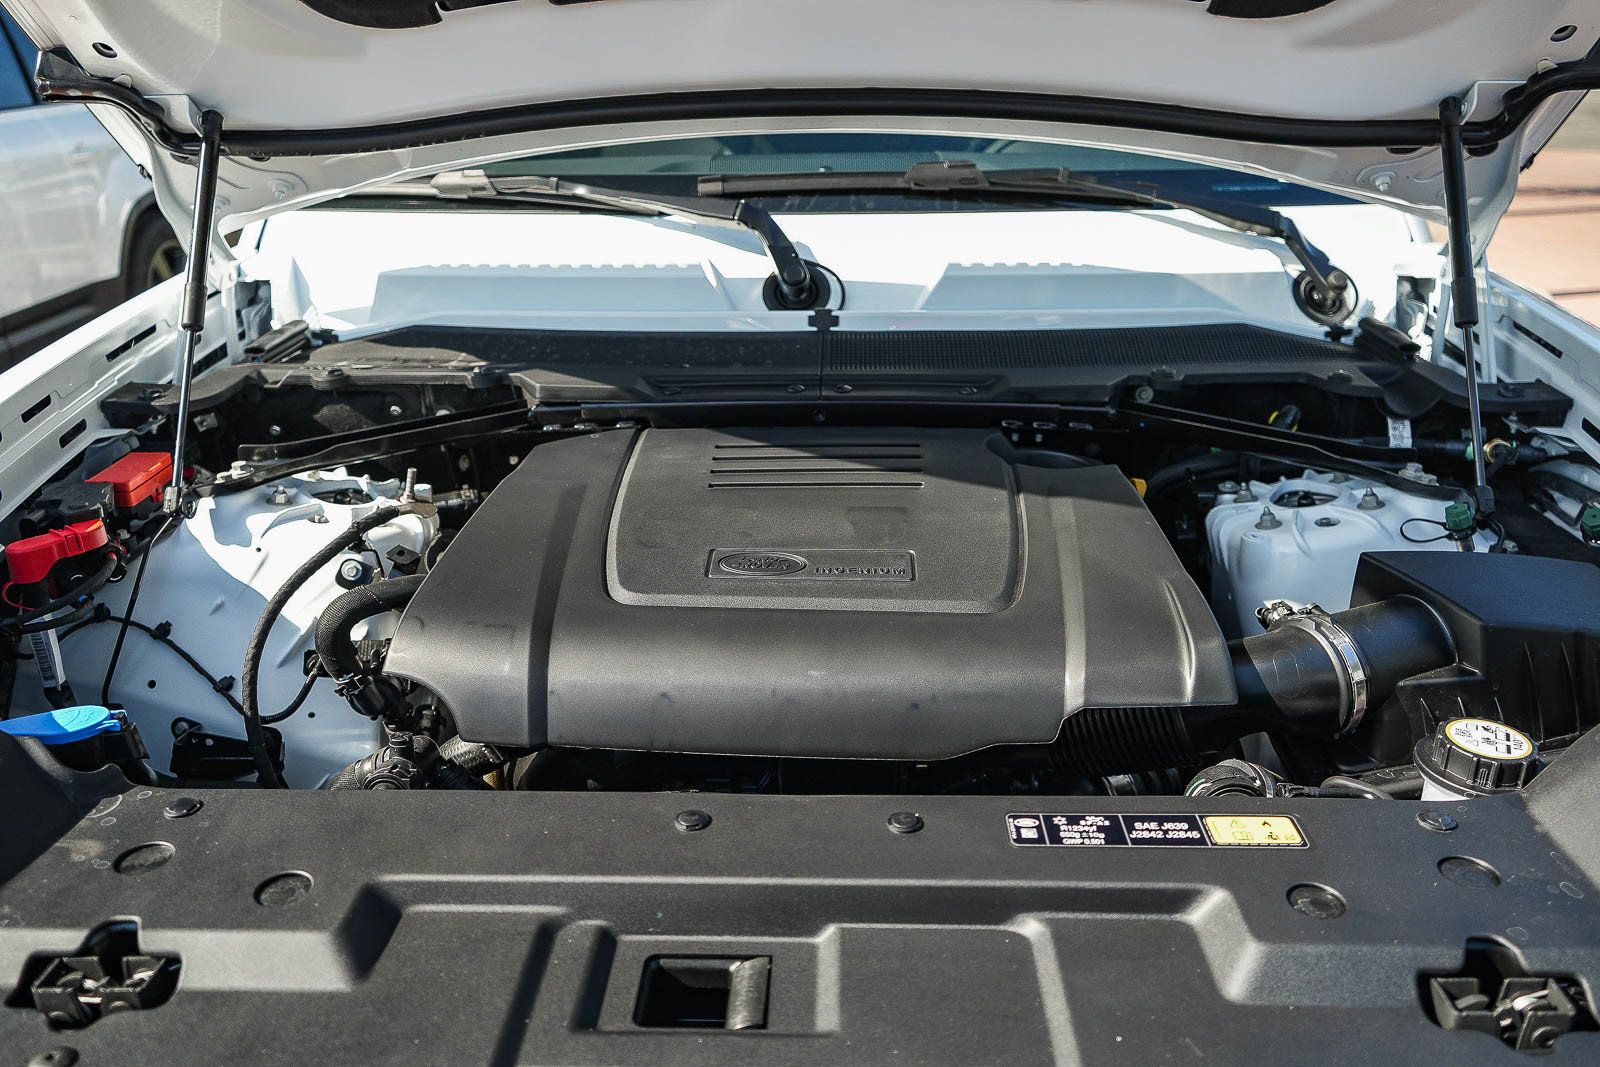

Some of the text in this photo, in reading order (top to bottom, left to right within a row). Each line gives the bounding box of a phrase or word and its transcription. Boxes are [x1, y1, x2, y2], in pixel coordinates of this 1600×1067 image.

[814, 566, 906, 575] INGENIUM
[1134, 822, 1189, 830] SAE J639
[1129, 830, 1165, 839] J2842
[1166, 830, 1201, 839] J2845
